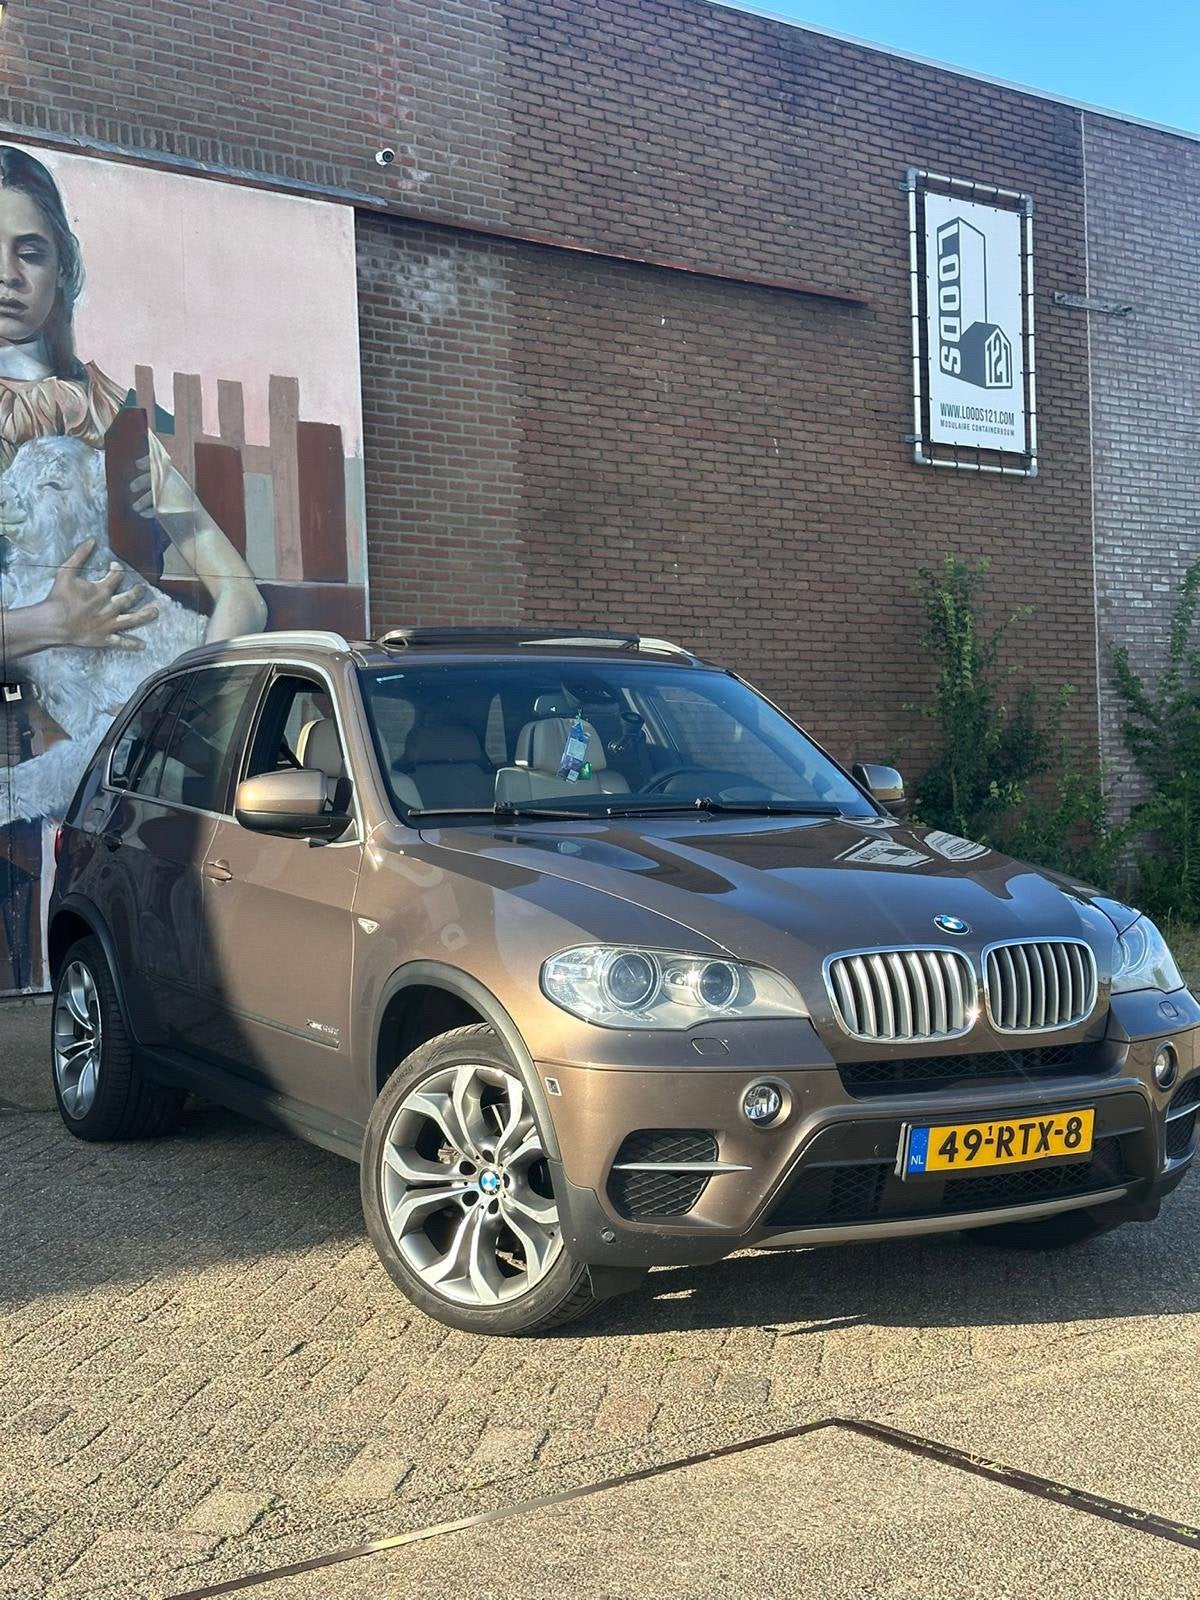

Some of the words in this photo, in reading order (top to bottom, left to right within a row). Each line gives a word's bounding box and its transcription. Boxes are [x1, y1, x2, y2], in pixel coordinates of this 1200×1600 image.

[938, 223, 961, 375] LOODS
[986, 332, 1010, 384] 121
[940, 402, 1015, 426] WWW.LOODS121.COM
[910, 1156, 924, 1166] NL
[938, 1116, 1083, 1163] 49-RTX-8
